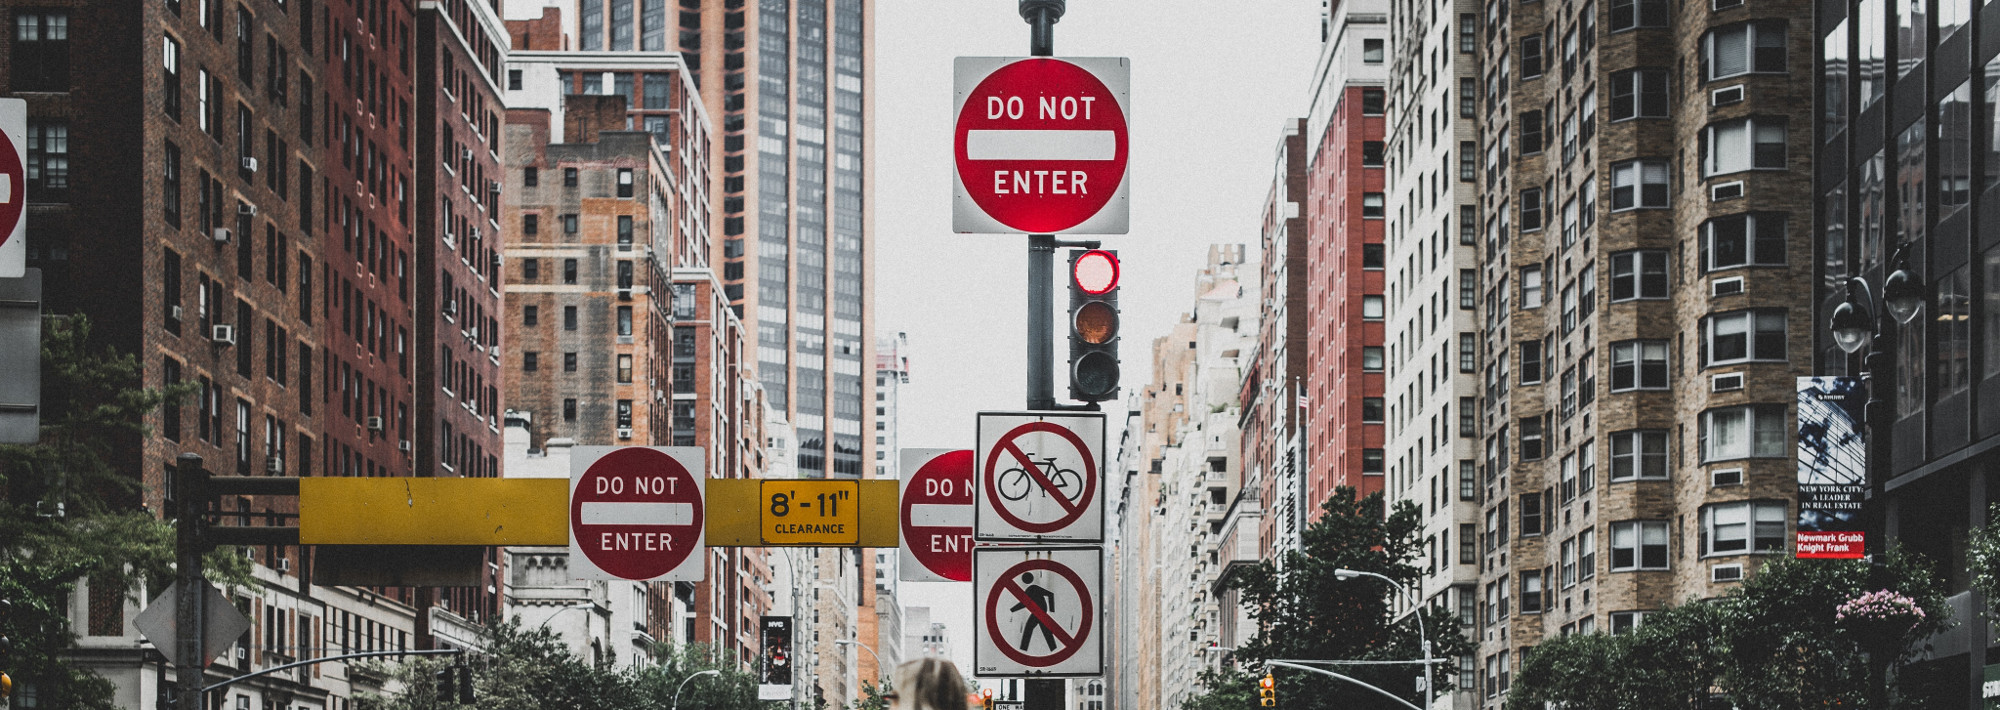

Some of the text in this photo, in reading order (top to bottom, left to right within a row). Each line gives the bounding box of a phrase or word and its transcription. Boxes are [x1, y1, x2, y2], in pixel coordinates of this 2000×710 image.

[987, 96, 1096, 120] DO NOT
[994, 170, 1088, 194] ENTER
[596, 476, 679, 495] DO NOT
[926, 478, 954, 497] DO
[775, 524, 845, 534] CLEARANCE
[1797, 533, 1864, 542] Newmark Grubb
[601, 532, 673, 551] ENTER
[931, 534, 973, 553] ENT
[1797, 543, 1850, 554] Knight Frank
